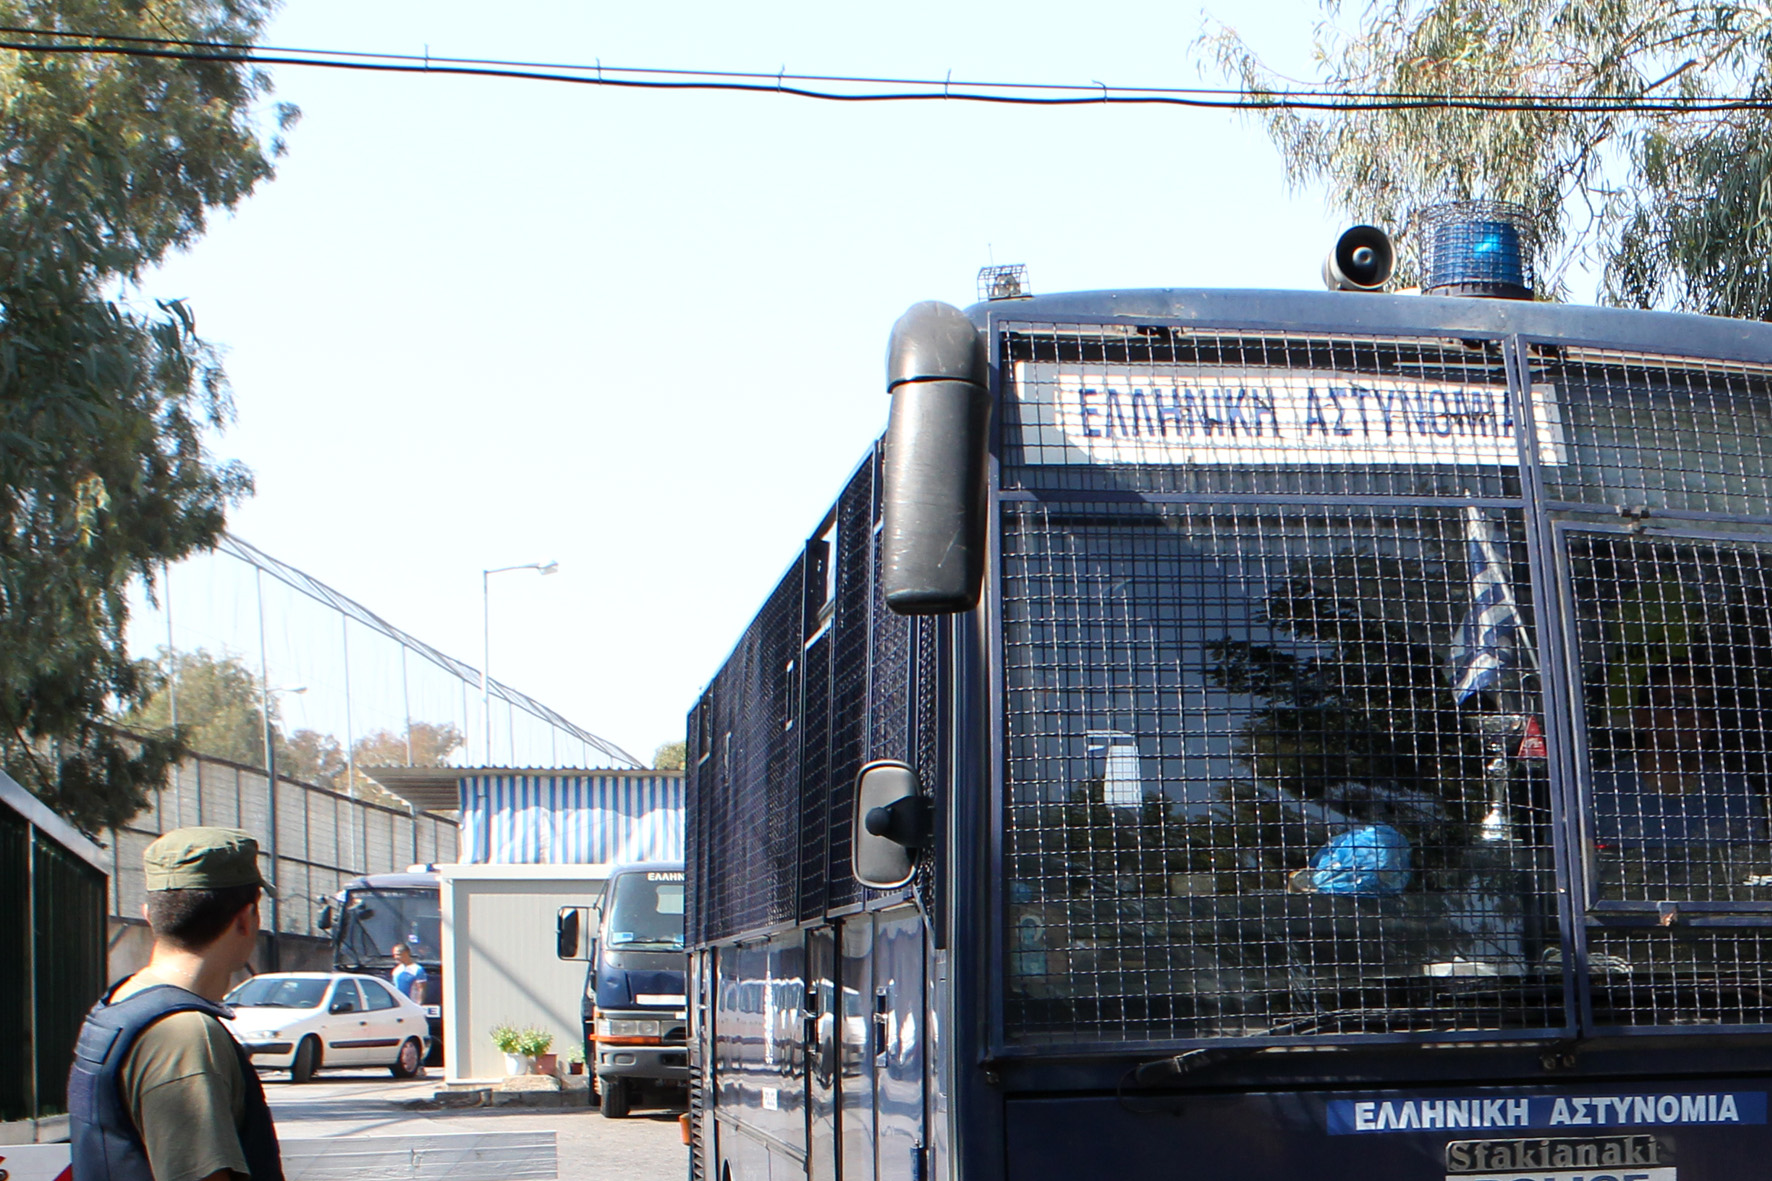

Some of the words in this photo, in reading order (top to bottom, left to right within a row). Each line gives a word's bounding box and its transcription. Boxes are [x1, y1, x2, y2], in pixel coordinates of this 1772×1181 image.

[1355, 1098, 1529, 1131] ΕΛΛΗΝΙΚΗ
[1549, 1094, 1739, 1126] ΑΣΤΥΝΟΜΙΑ
[1449, 1135, 1659, 1171] Sfakianaki
